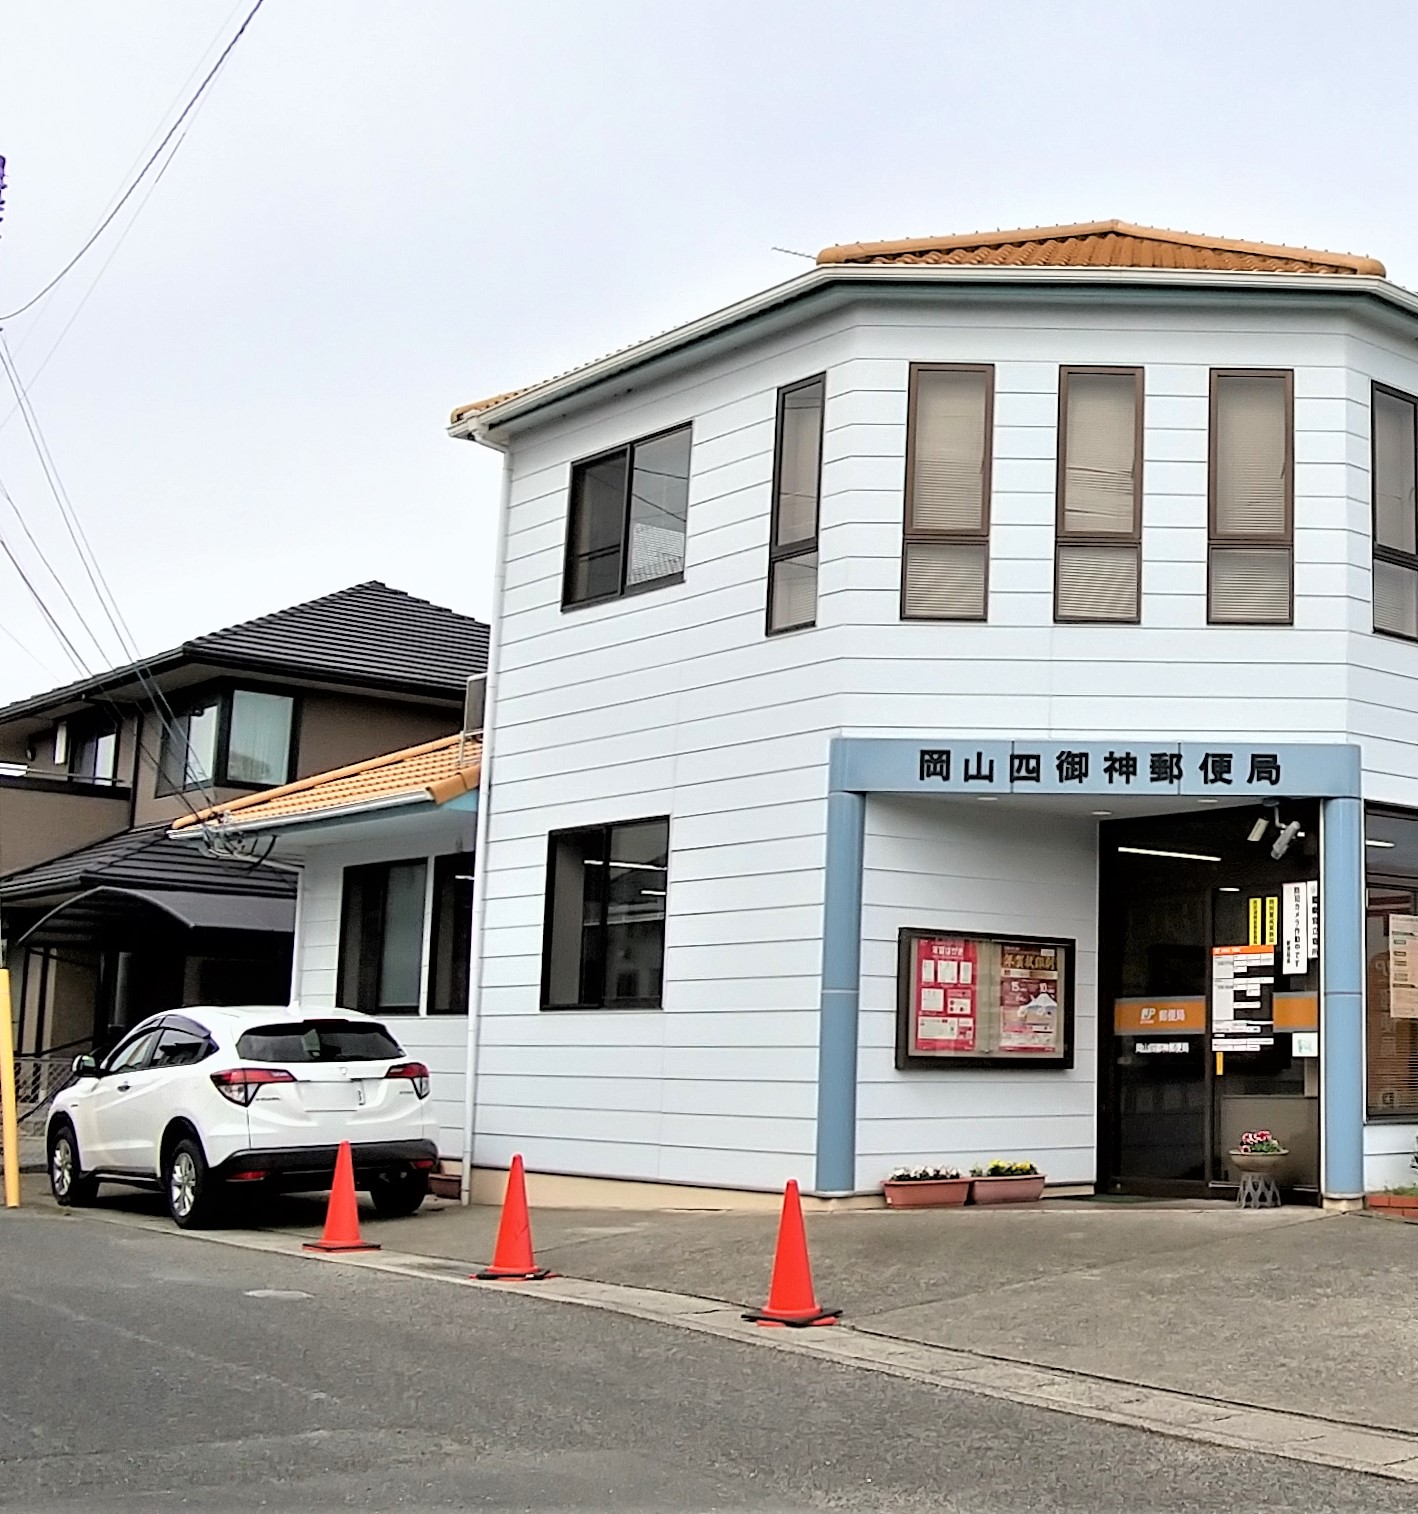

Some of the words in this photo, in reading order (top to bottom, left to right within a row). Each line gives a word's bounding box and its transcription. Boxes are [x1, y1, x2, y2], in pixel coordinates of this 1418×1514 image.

[919, 749, 1281, 786] 岡山四御神郵便局
